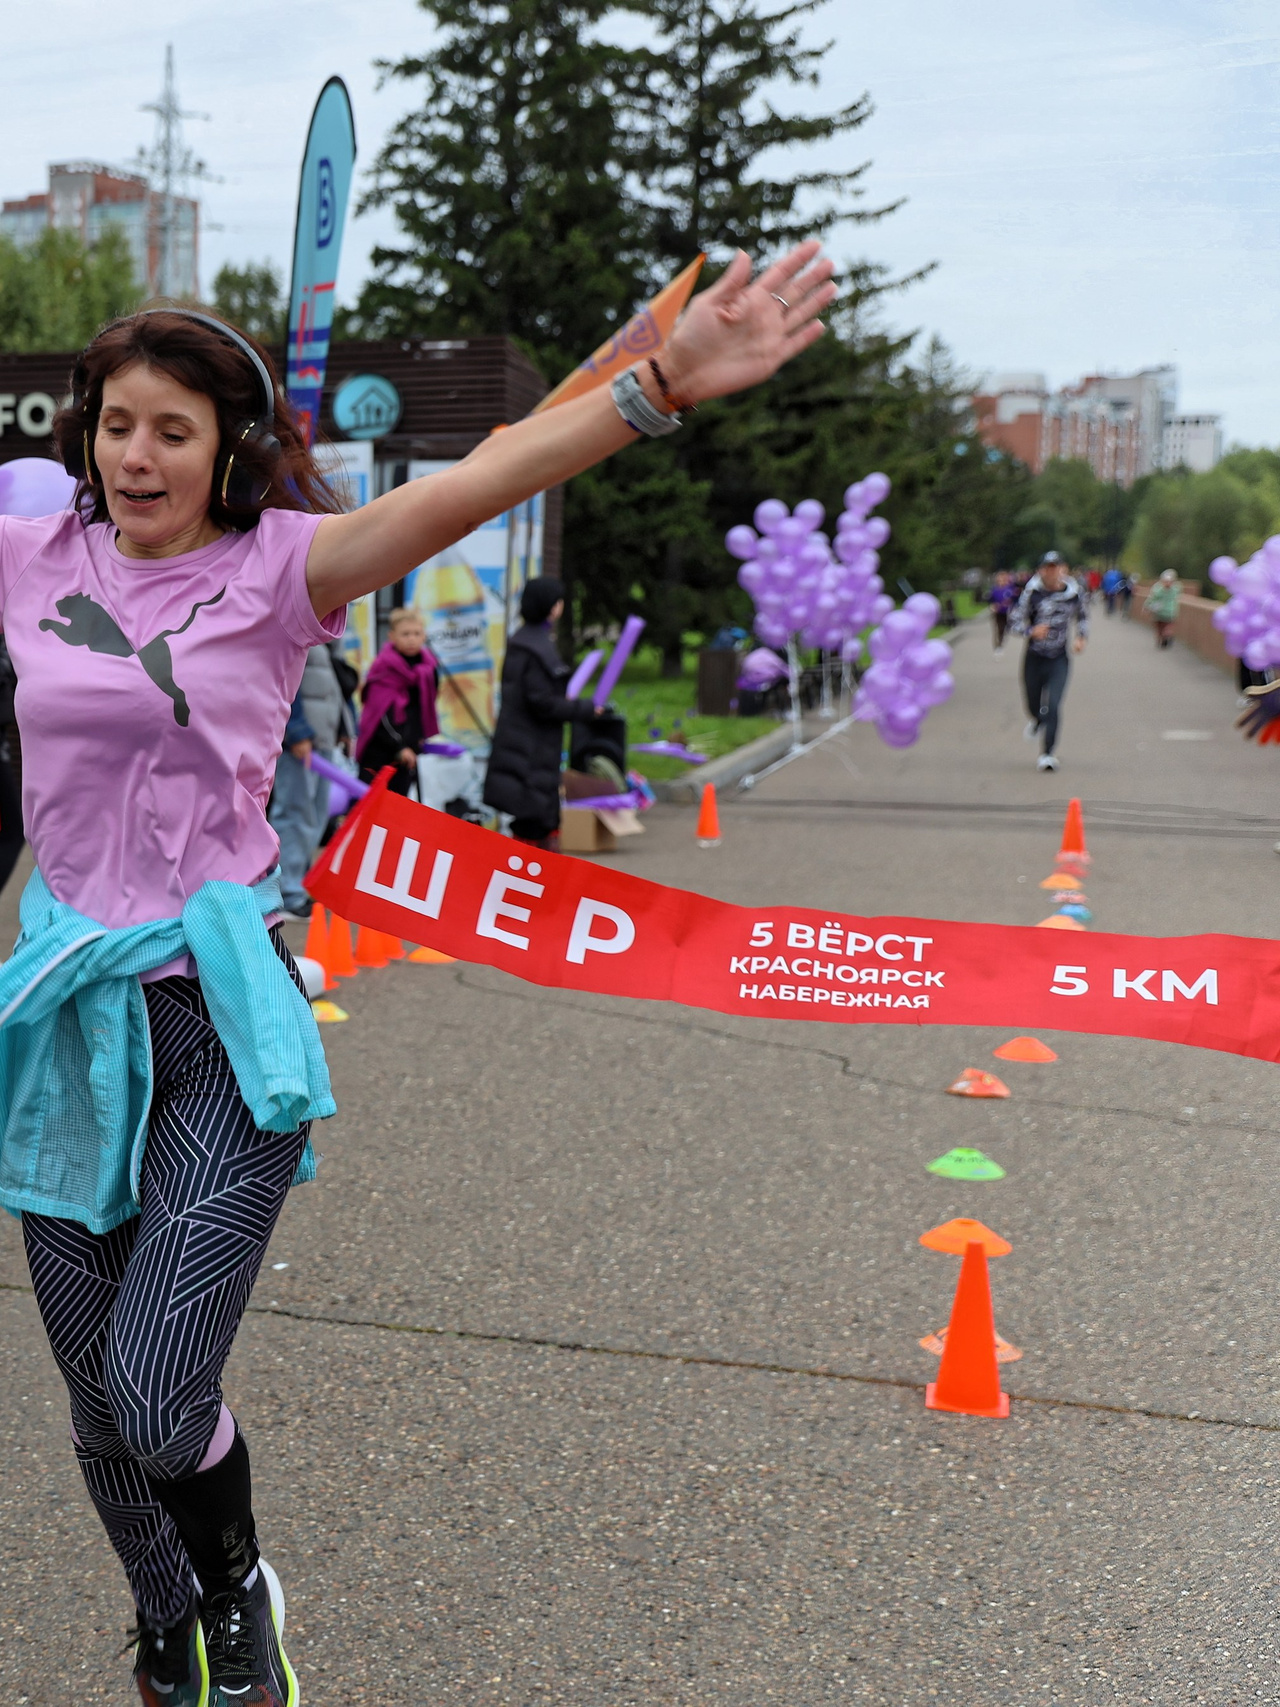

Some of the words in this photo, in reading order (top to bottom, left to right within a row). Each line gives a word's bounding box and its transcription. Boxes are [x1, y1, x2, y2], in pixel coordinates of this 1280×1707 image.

[329, 814, 636, 965] ШЁР
[749, 922, 774, 948] 5
[787, 921, 933, 962] ВЁРСТ
[729, 956, 945, 988] КРАСНОЯРСК
[1049, 965, 1089, 996] 5
[1113, 968, 1219, 1006] КМ
[739, 983, 930, 1009] НАБЕРЕЖНАЯ
